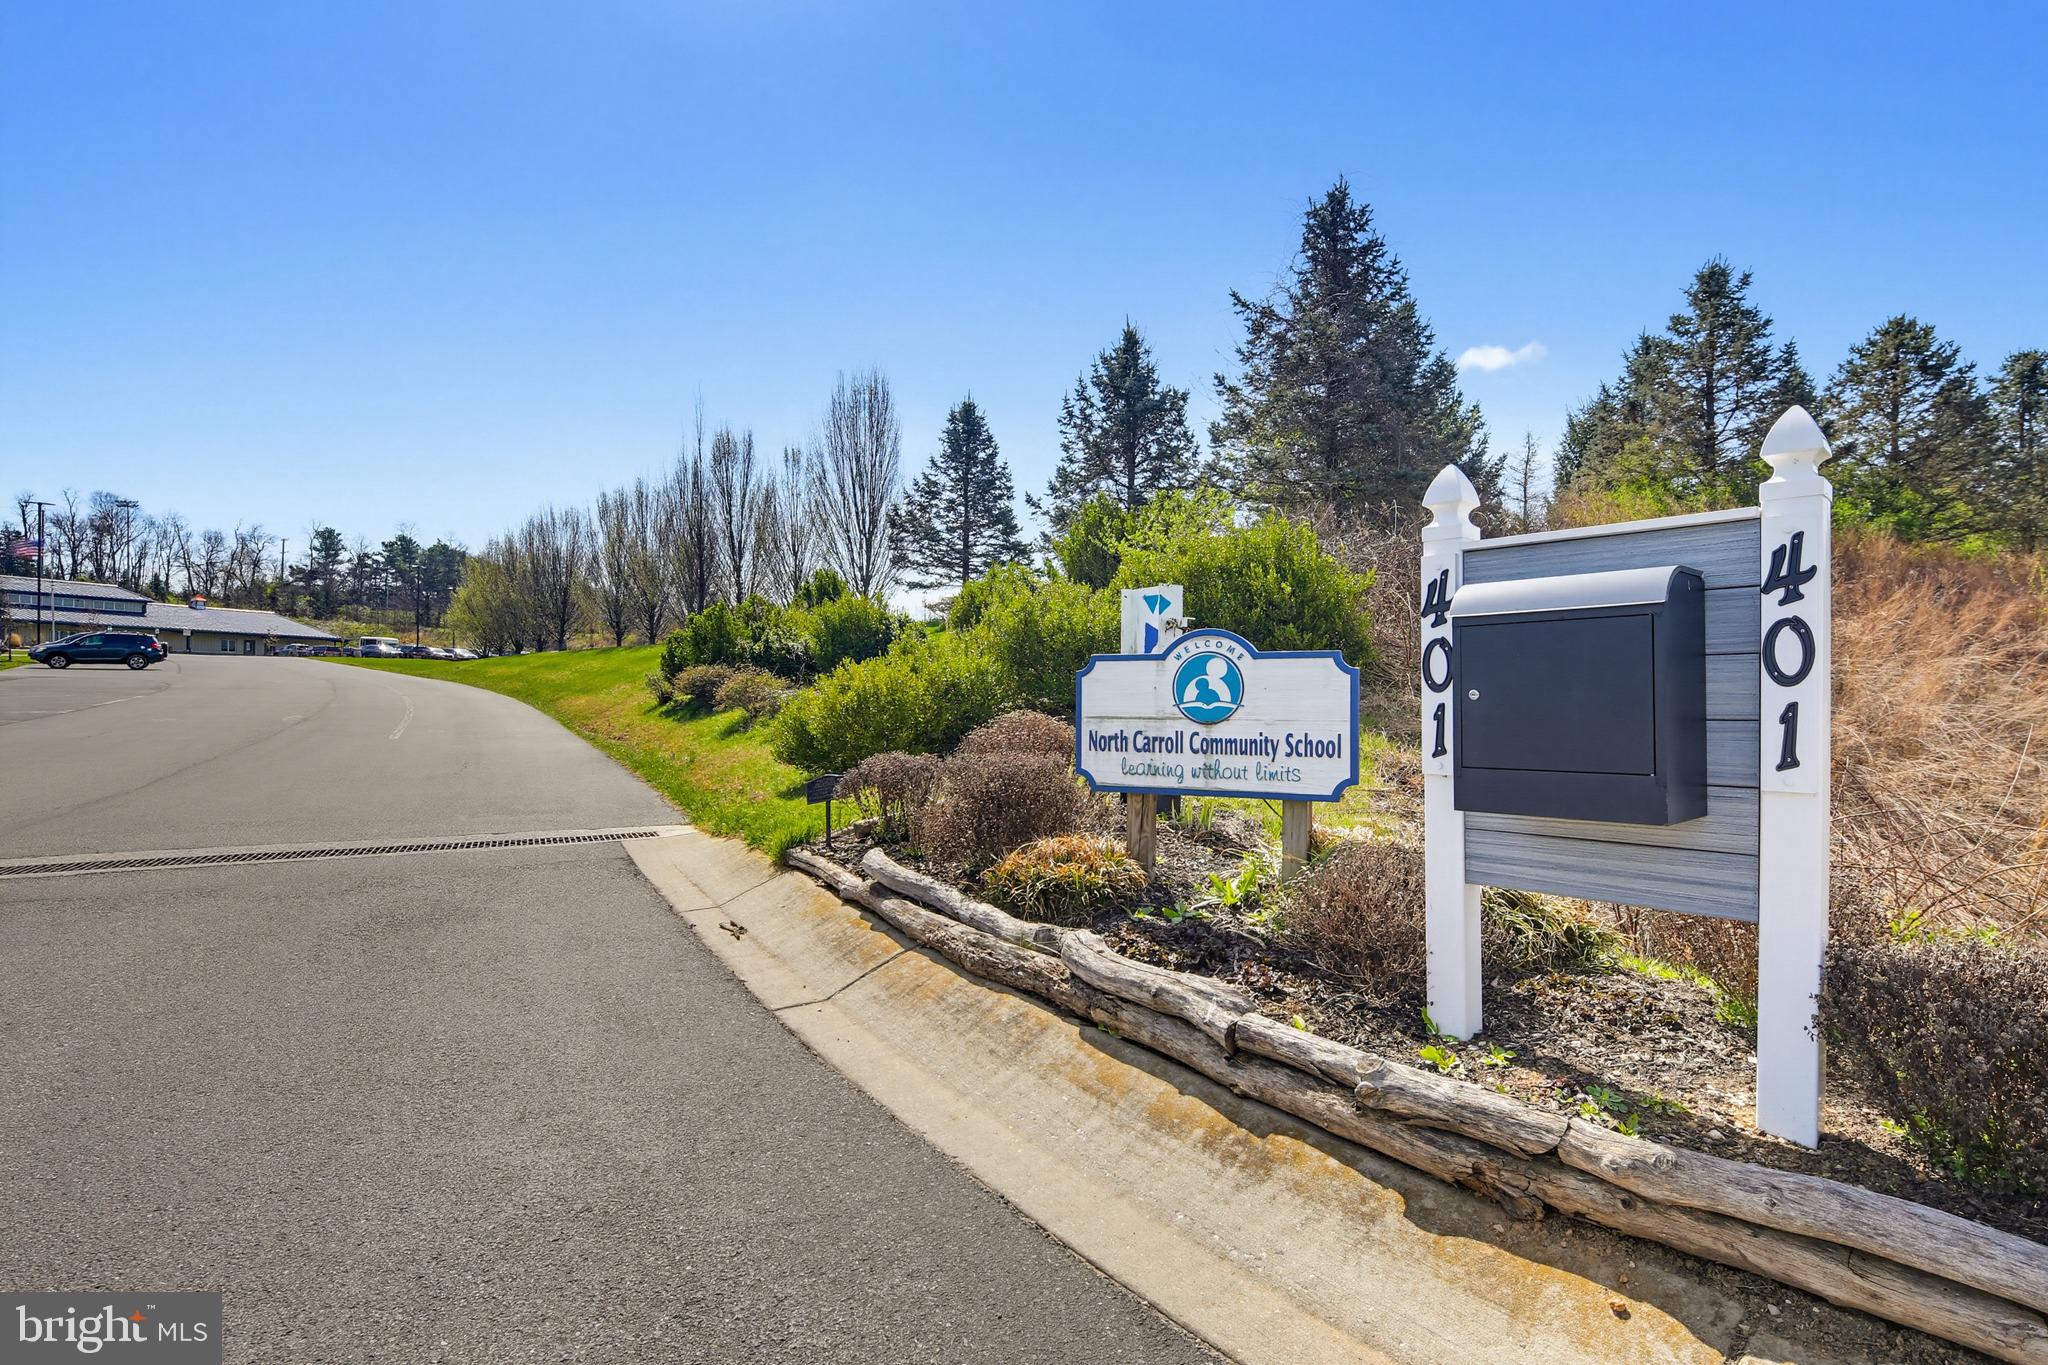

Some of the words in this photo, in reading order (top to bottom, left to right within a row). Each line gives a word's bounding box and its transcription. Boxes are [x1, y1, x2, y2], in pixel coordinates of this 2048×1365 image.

[1173, 639, 1245, 661] WELCOME
[1421, 568, 1453, 758] 401
[1761, 531, 1817, 771] 401
[1088, 729, 1128, 752] North
[1132, 730, 1184, 754] Carroll
[1189, 731, 1279, 762] Community
[1285, 732, 1342, 758] School
[1121, 757, 1184, 783] learning
[1191, 759, 1248, 781] without
[1255, 761, 1301, 782] limits
